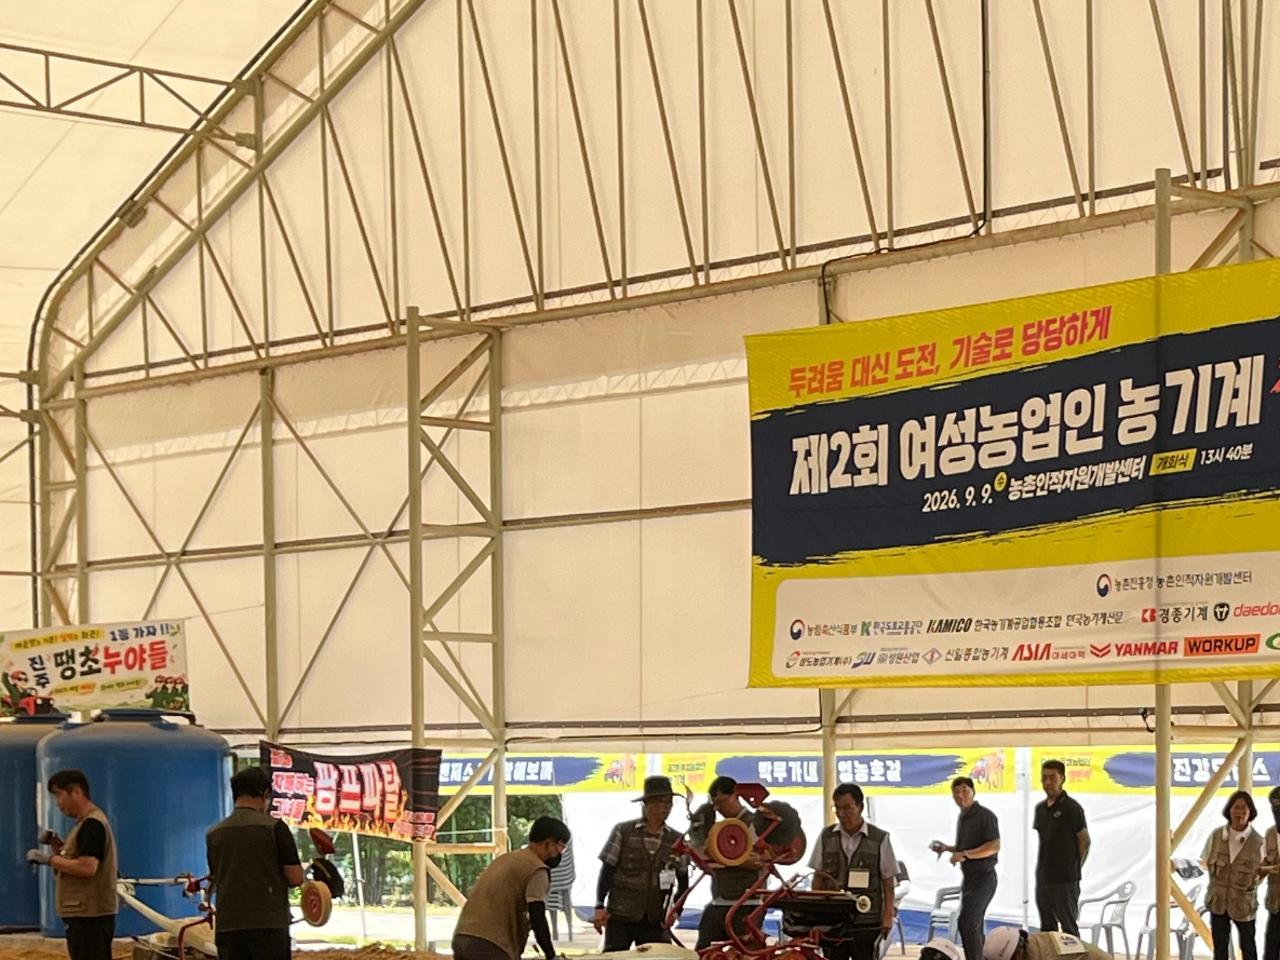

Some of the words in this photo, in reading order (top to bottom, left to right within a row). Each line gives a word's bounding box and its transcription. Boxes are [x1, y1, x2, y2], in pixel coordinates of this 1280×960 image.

[788, 359, 846, 399] 두려움
[849, 352, 891, 389] 대신
[896, 344, 941, 379] 도전,
[950, 328, 1013, 369] 기술로
[1021, 306, 1112, 357] 당당하게
[788, 423, 889, 496] 제2회
[899, 383, 1107, 480] 여성농업인
[922, 488, 960, 512] 2026.
[965, 486, 977, 507] 9.
[981, 483, 993, 504] 9.
[1007, 455, 1147, 502] 농촌인적자원개발센터
[1156, 452, 1189, 471] 개회식
[1200, 447, 1226, 466] 13시
[1225, 442, 1254, 461] 40분
[1114, 577, 1154, 592] 농촌진흥청
[1156, 570, 1253, 590] 농촌인적자원개발센터
[926, 617, 972, 634] KAMICO
[1114, 641, 1179, 657] YANMAR
[1187, 637, 1257, 654] WORKUP
